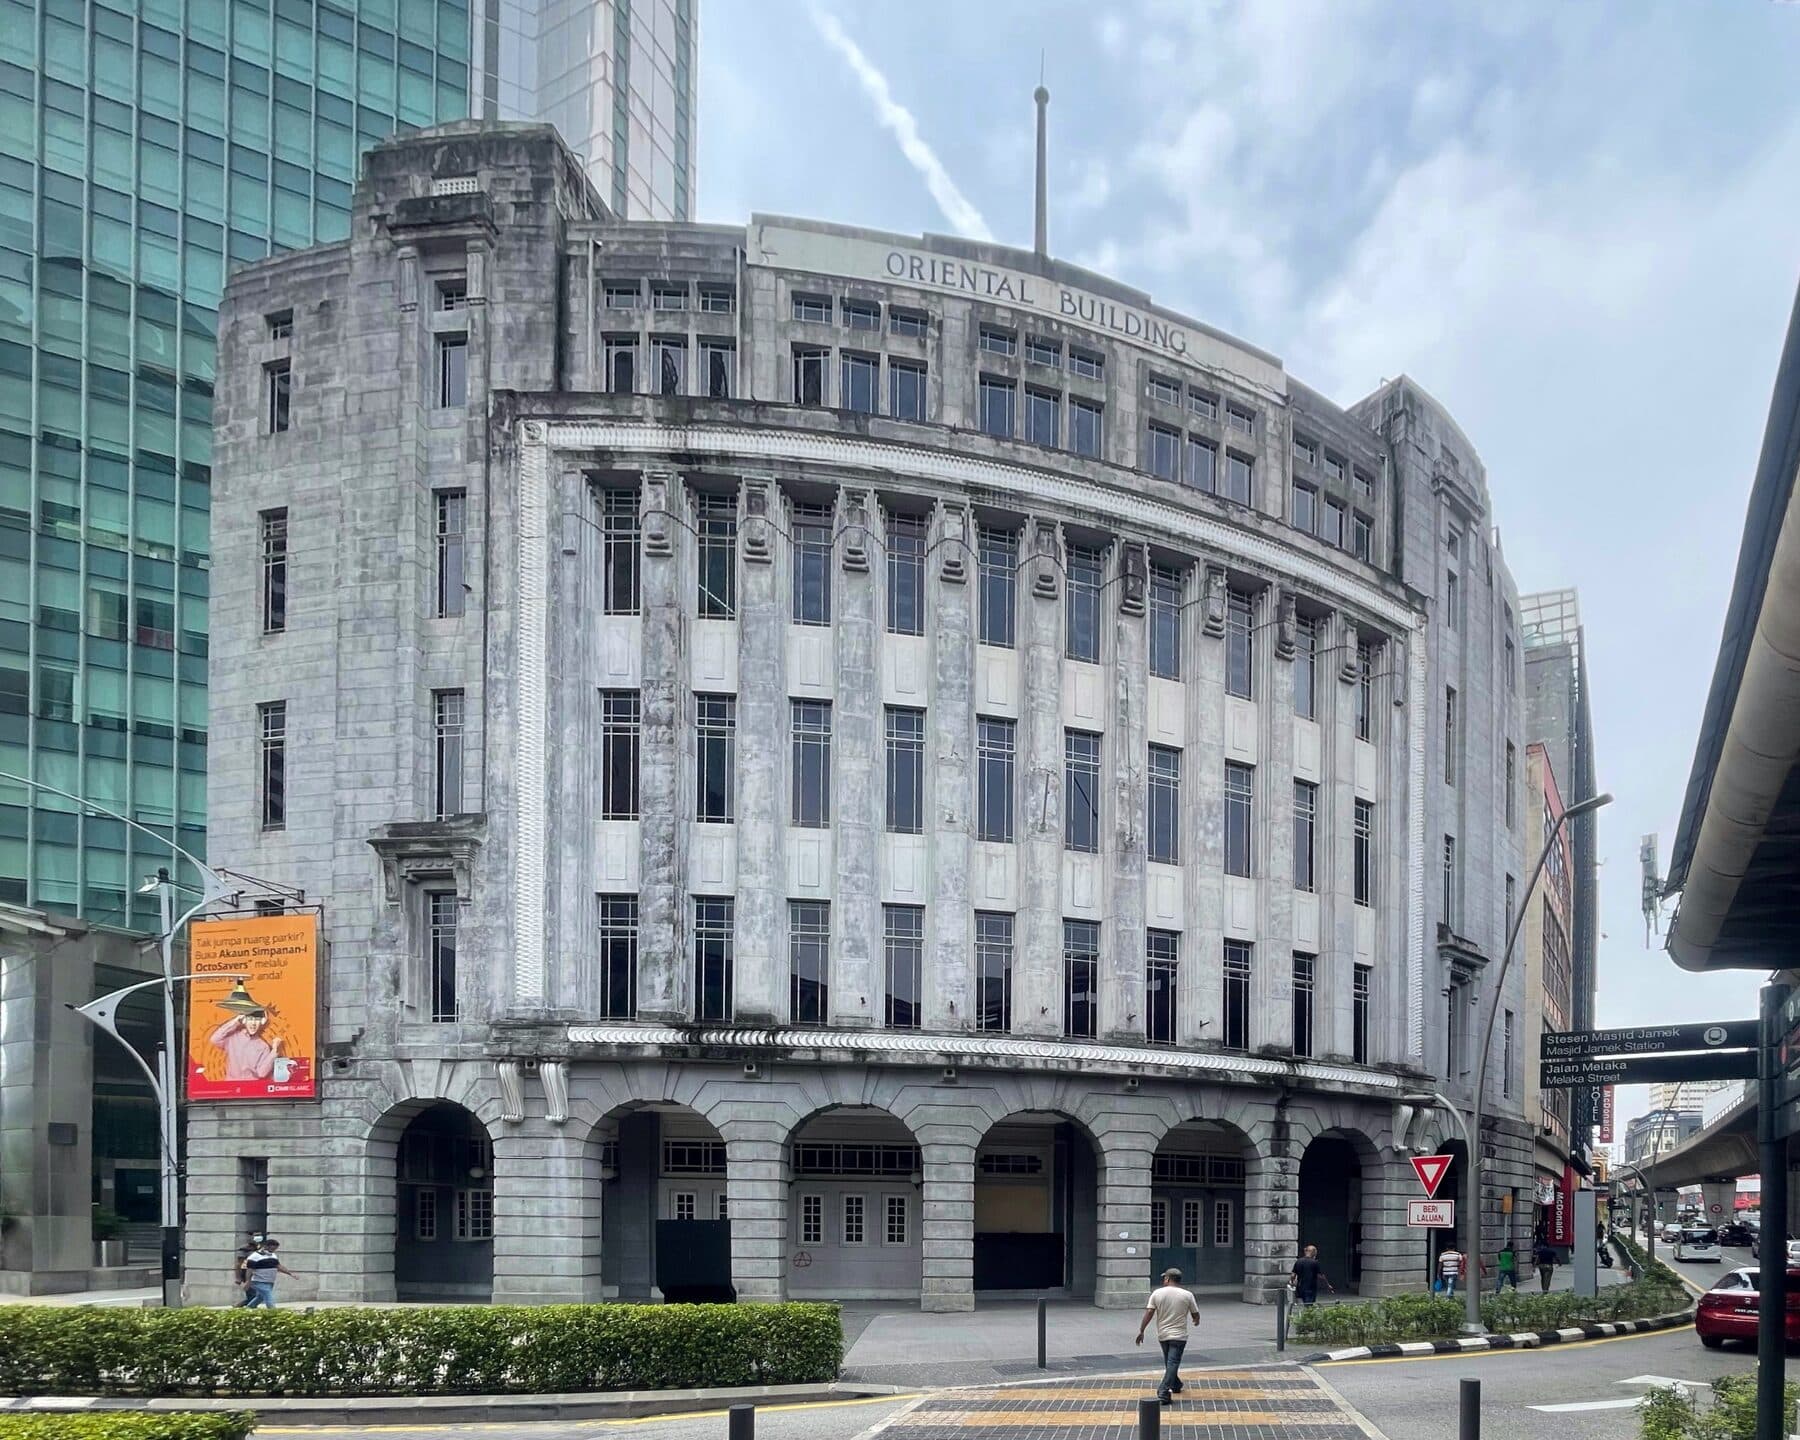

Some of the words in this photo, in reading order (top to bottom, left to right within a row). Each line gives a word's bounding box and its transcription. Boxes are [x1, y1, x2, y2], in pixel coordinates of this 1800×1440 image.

[886, 251, 1034, 304] ORIENTAL
[1060, 289, 1187, 354] BUILDING
[213, 936, 242, 949] jumpa
[243, 934, 271, 945] ruang
[272, 932, 305, 944] parkir?
[219, 948, 250, 958] Akaun
[254, 959, 288, 968] melalui
[257, 971, 283, 980] anda!
[1546, 1034, 1589, 1045] Stesen
[1591, 1030, 1634, 1043] Masjid
[1638, 1028, 1680, 1039] Jamek
[1546, 1046, 1581, 1057] Masjid
[1584, 1043, 1622, 1053] Jamek
[1624, 1041, 1665, 1051] Station
[1546, 1063, 1579, 1073] Jalan
[1582, 1061, 1627, 1071] Melaka
[1546, 1075, 1584, 1085] Melaka
[1588, 1073, 1621, 1083] Street
[1591, 1086, 1600, 1121] HOTEL
[1417, 1214, 1444, 1222] LALUAN
